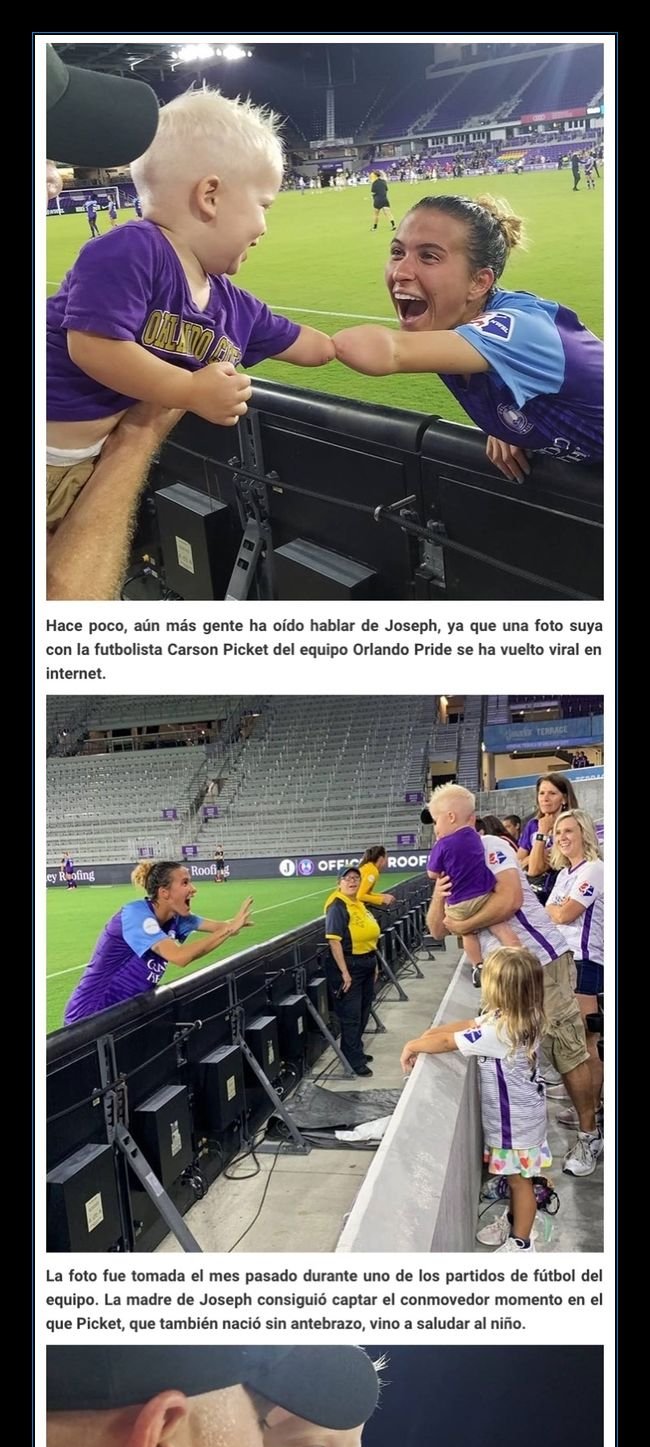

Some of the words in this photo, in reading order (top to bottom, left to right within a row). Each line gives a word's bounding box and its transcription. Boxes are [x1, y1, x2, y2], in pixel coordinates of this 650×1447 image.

[388, 854, 429, 869] ROOF
[59, 869, 95, 884] Rofing
[192, 864, 230, 877] Roofig
